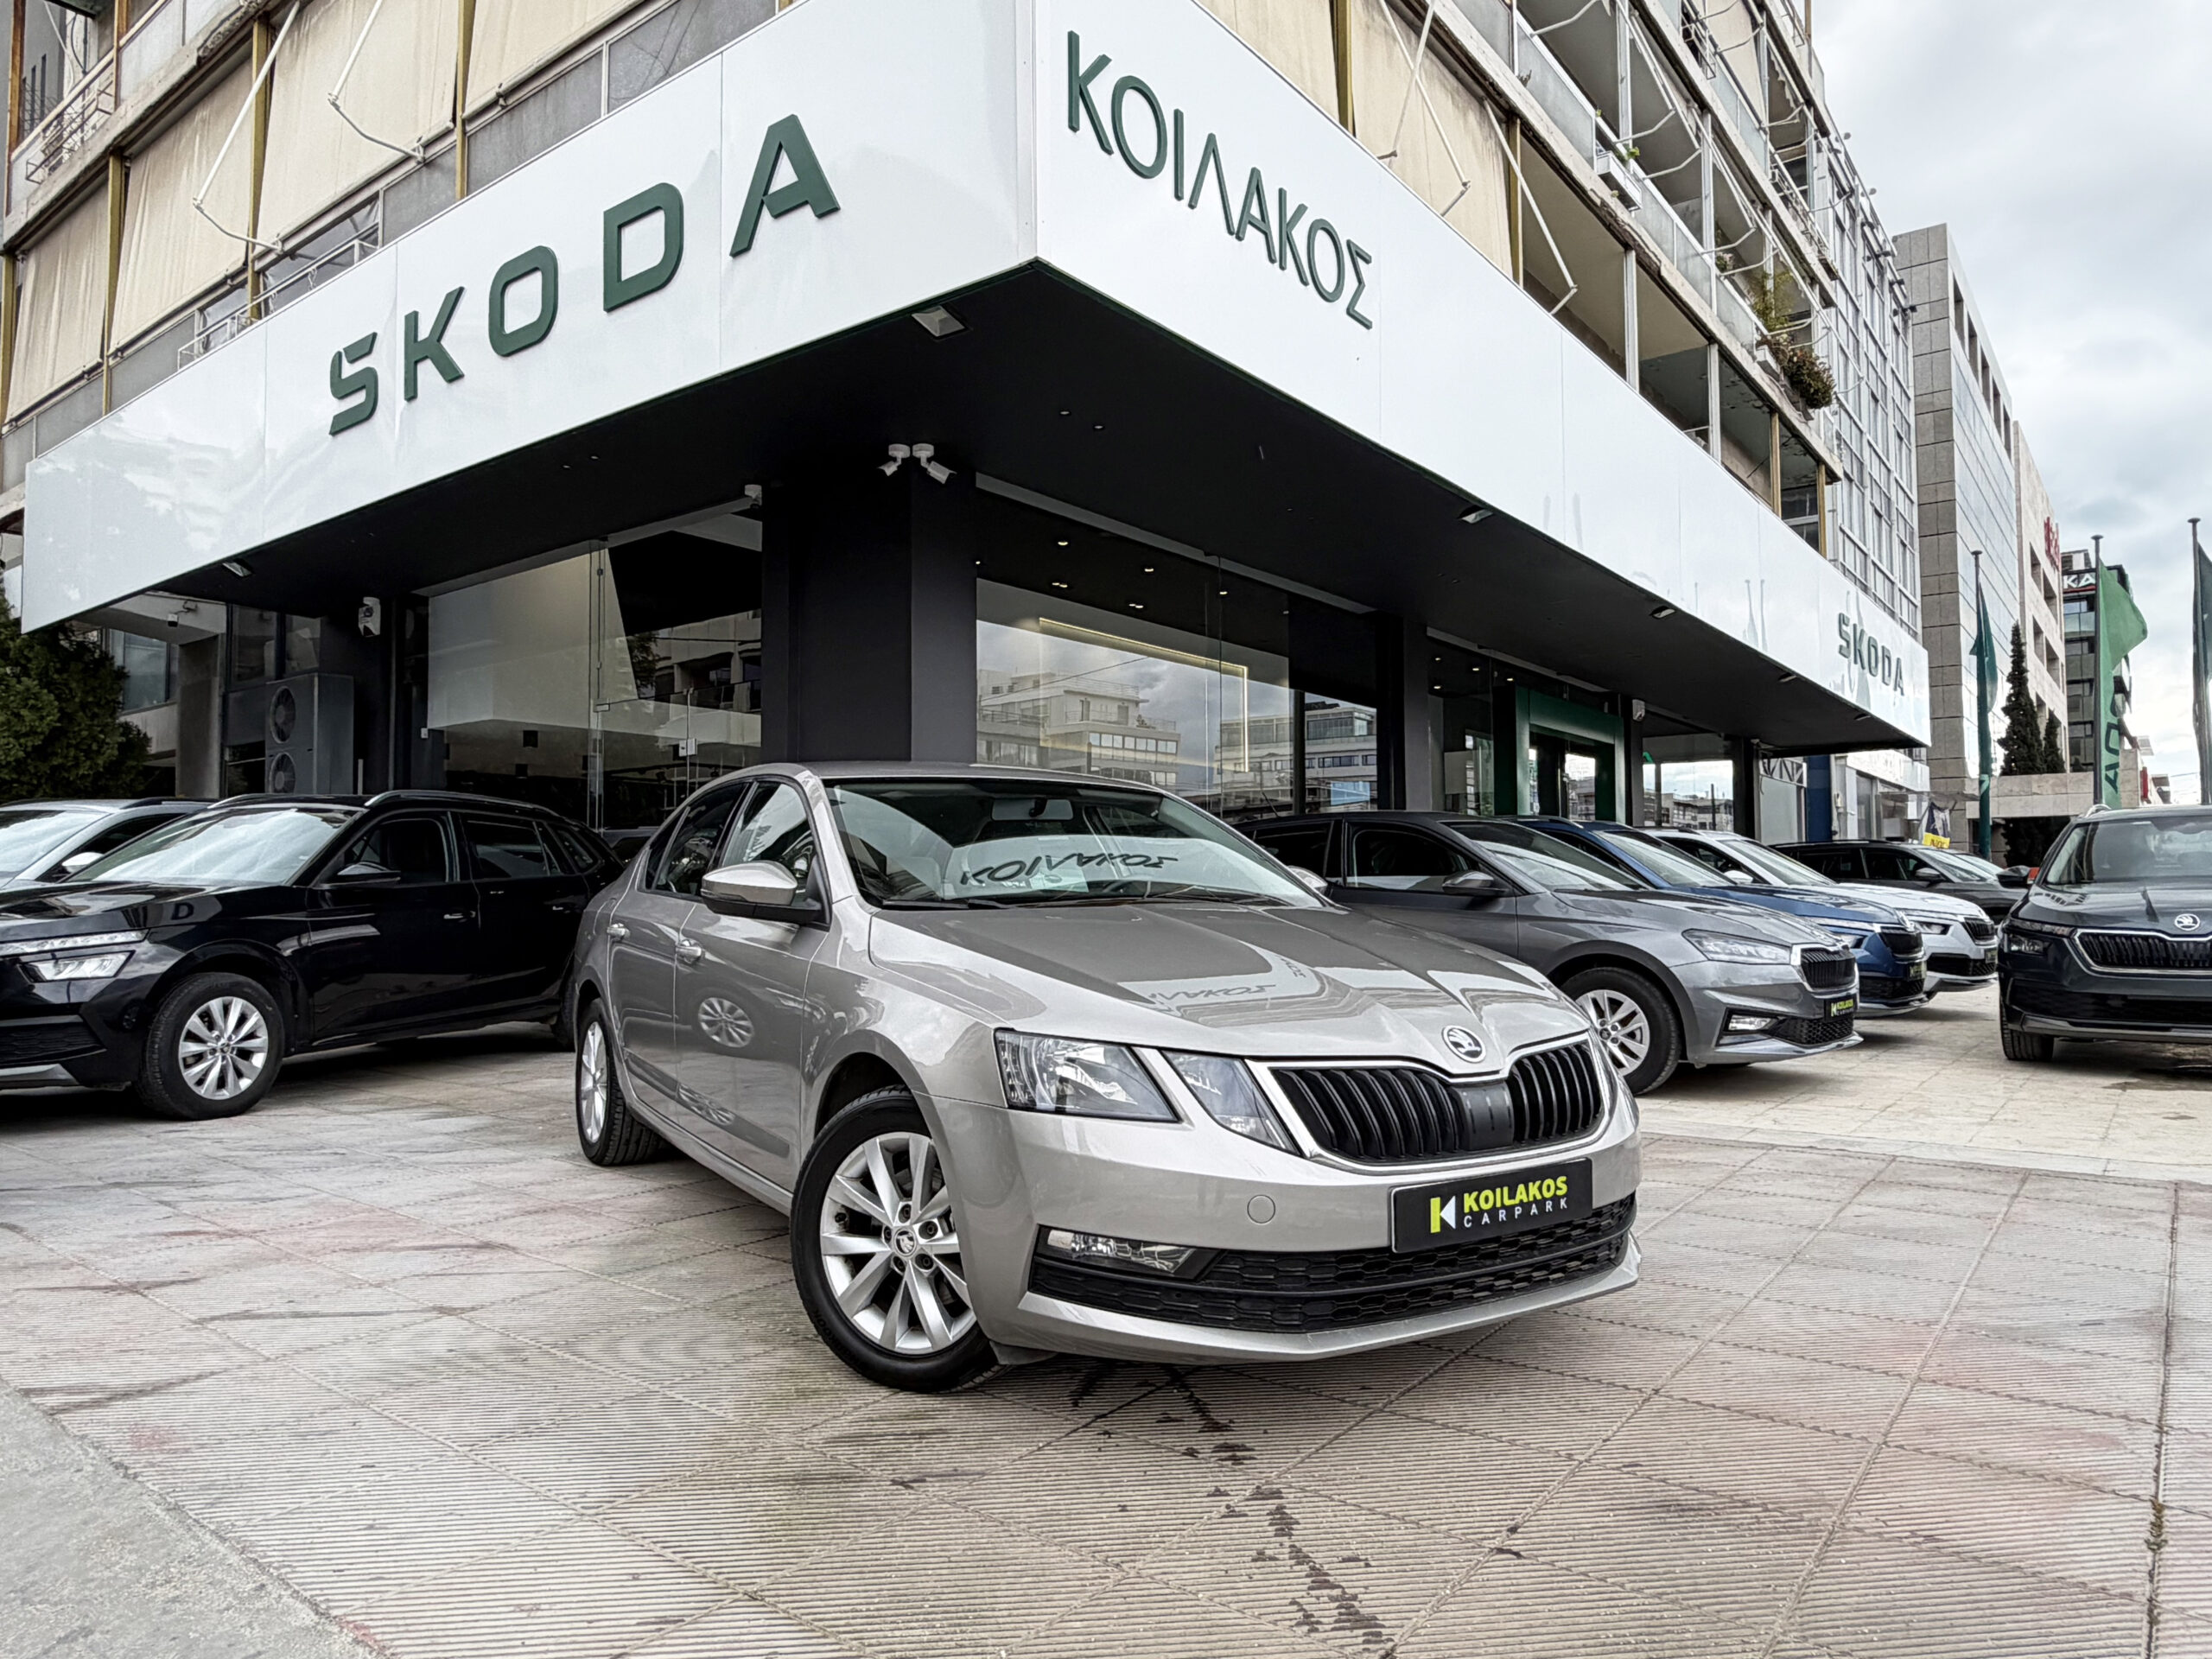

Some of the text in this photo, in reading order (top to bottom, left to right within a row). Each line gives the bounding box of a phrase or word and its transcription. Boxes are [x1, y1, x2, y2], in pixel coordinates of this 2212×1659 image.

[1068, 30, 1373, 330] ΚΟΙΛΑΚΟΣ
[1463, 1175, 1568, 1214] KOILAKOS
[1463, 1197, 1568, 1229] CARPARK
